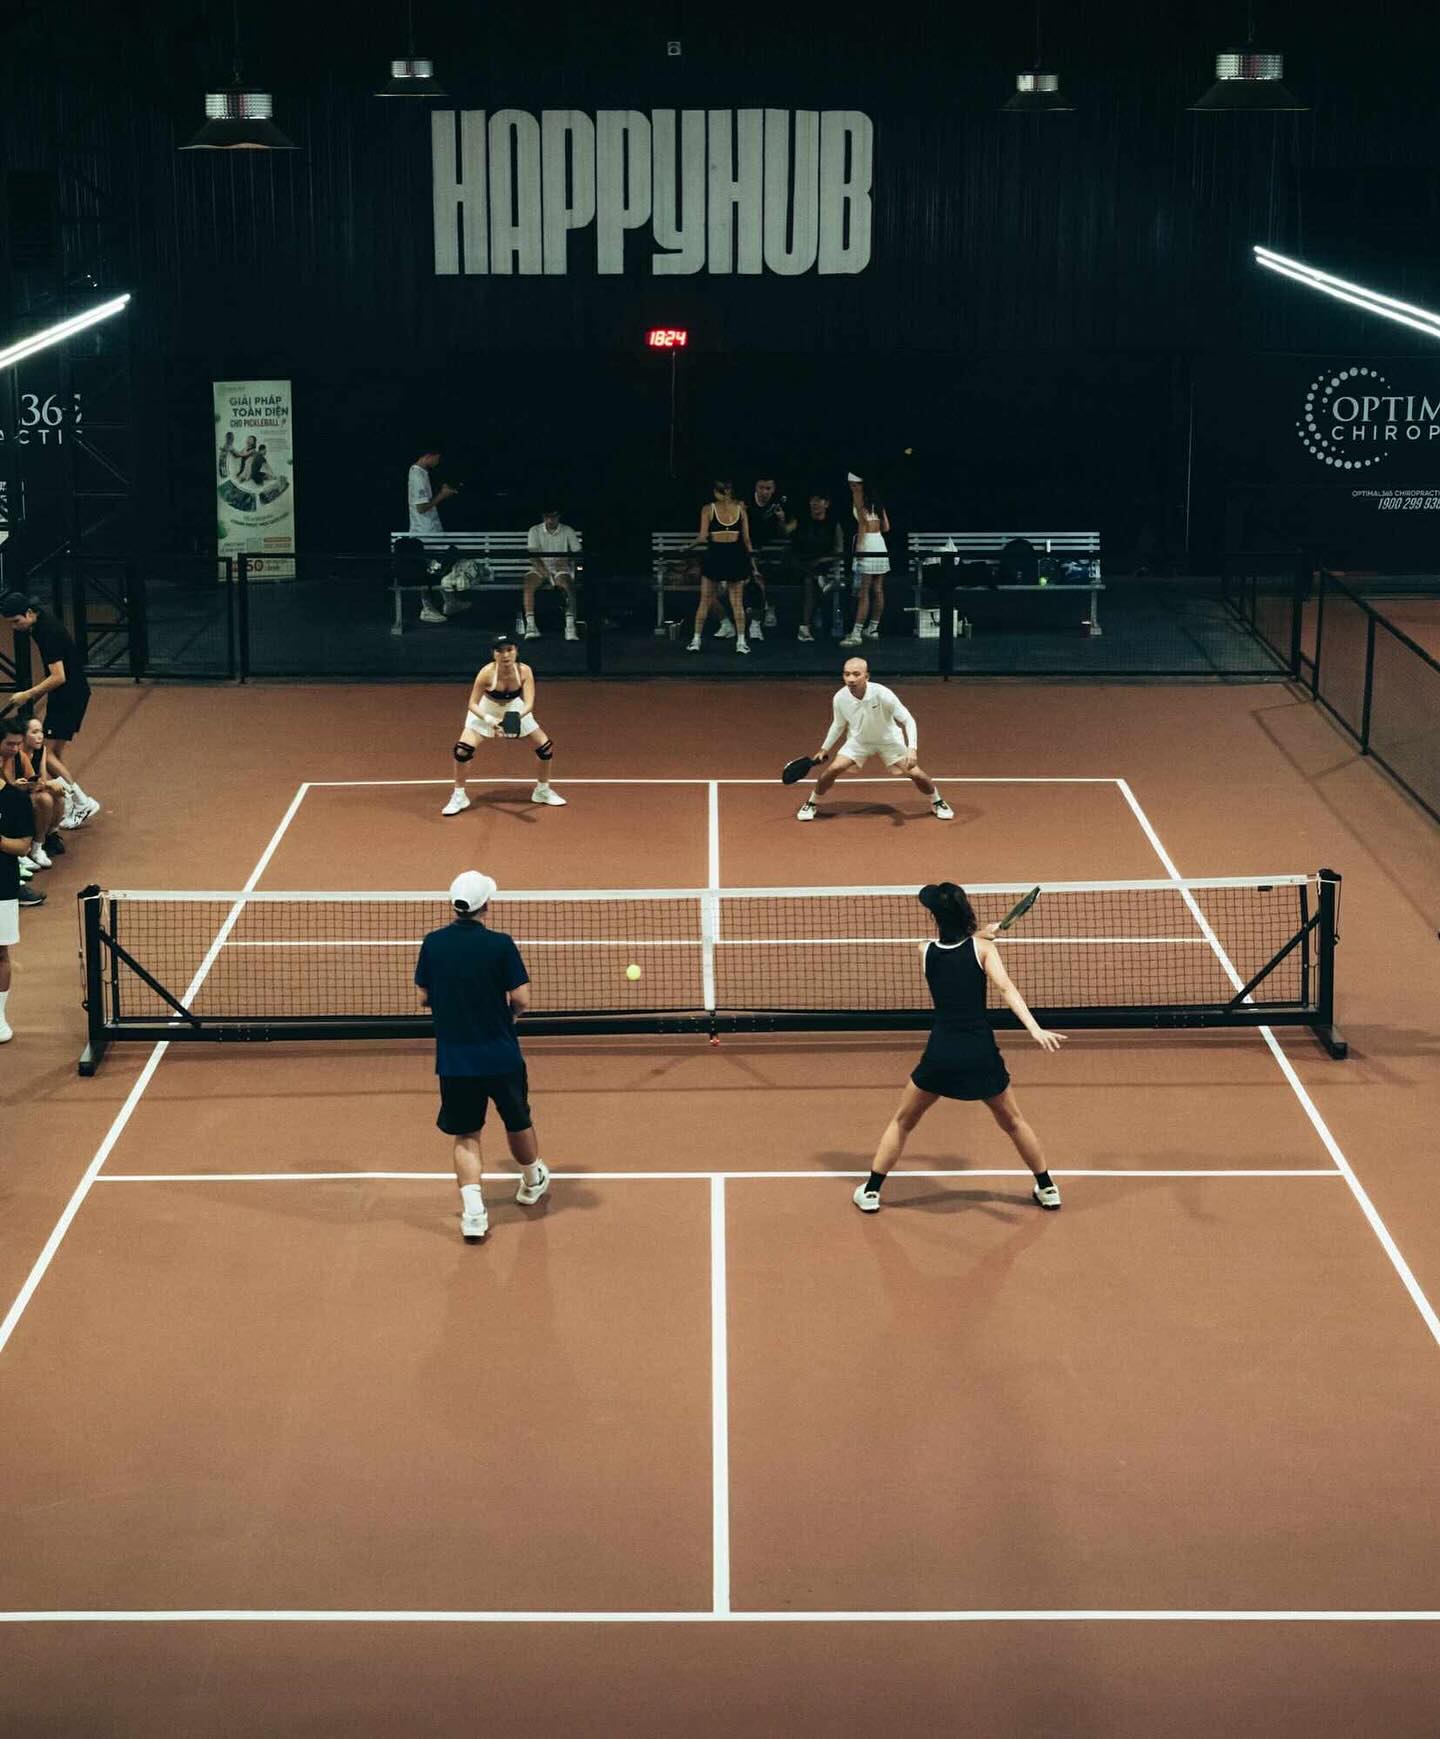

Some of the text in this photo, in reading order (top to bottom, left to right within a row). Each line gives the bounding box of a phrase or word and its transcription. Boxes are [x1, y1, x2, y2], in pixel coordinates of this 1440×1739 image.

[430, 108, 874, 277] HAPPYHUB
[254, 394, 282, 406] PHÁP
[232, 404, 289, 418] TOÀN DIỆN
[243, 418, 279, 427] PICKLEBALL
[1378, 497, 1403, 510] 1900
[1402, 497, 1424, 510] 299
